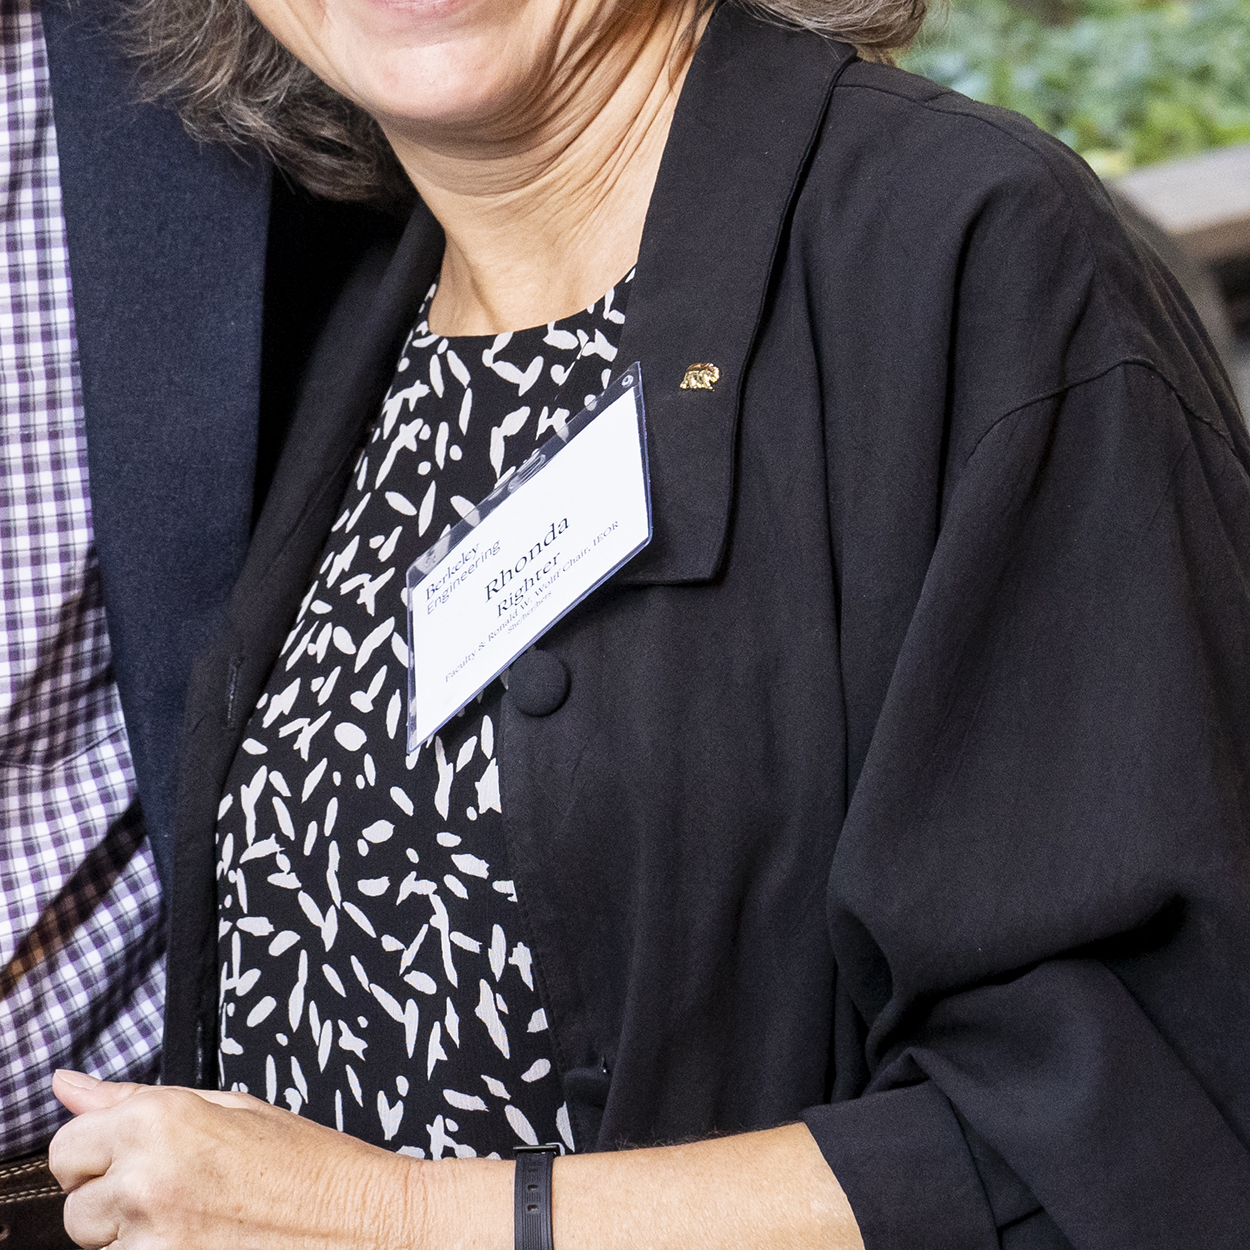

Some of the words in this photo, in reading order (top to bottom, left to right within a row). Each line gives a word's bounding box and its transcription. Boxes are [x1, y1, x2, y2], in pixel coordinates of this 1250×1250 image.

[426, 543, 480, 601] Berkeley
[427, 540, 500, 615] Engineering
[485, 517, 570, 603] Rhonda
[496, 552, 561, 618] Righter
[445, 649, 477, 682] Faculty
[488, 608, 518, 642] Ronald
[534, 568, 561, 596] Wolff
[562, 547, 591, 572] Chair,
[592, 521, 618, 546] IEOR
